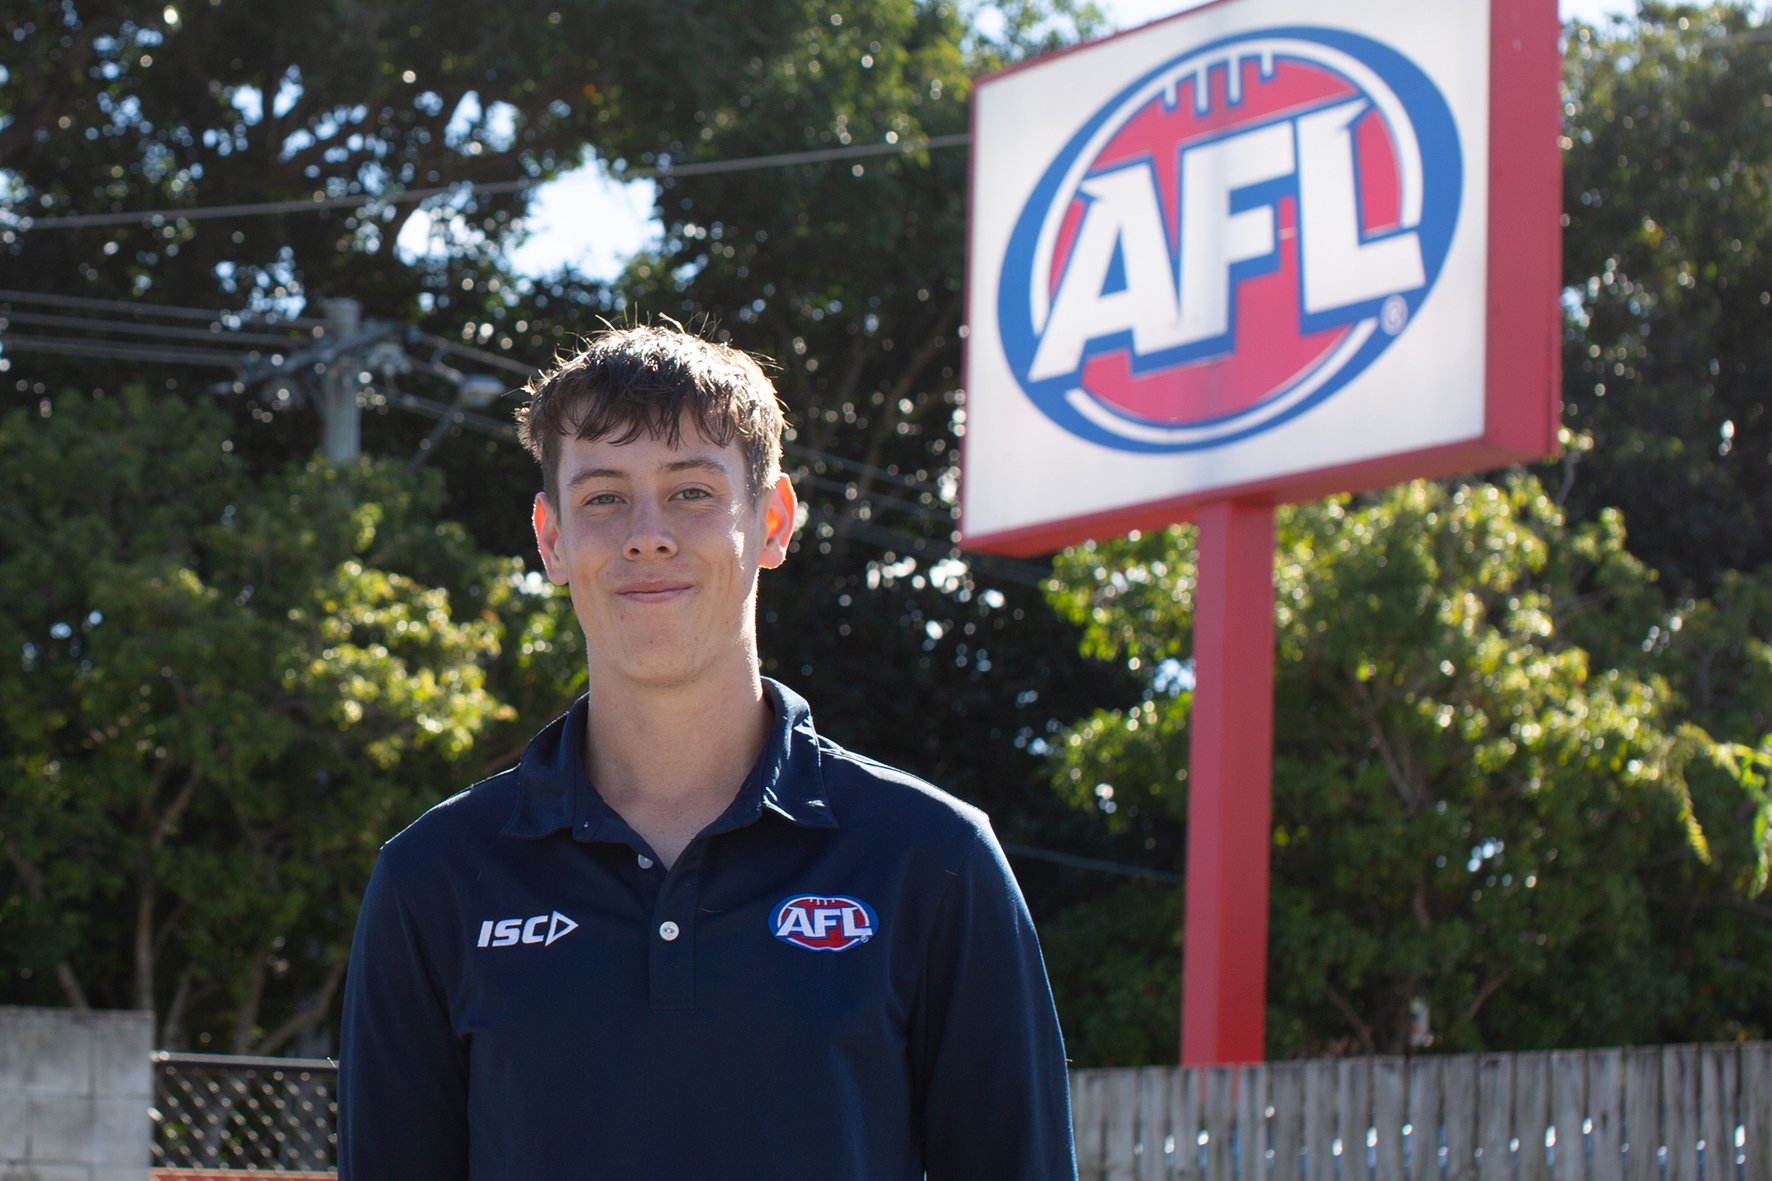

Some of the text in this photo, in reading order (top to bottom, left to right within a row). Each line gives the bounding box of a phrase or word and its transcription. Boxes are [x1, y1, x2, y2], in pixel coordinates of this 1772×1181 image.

[1027, 97, 1427, 383] AFL
[476, 914, 549, 948] ISC
[775, 906, 873, 937] AFL
